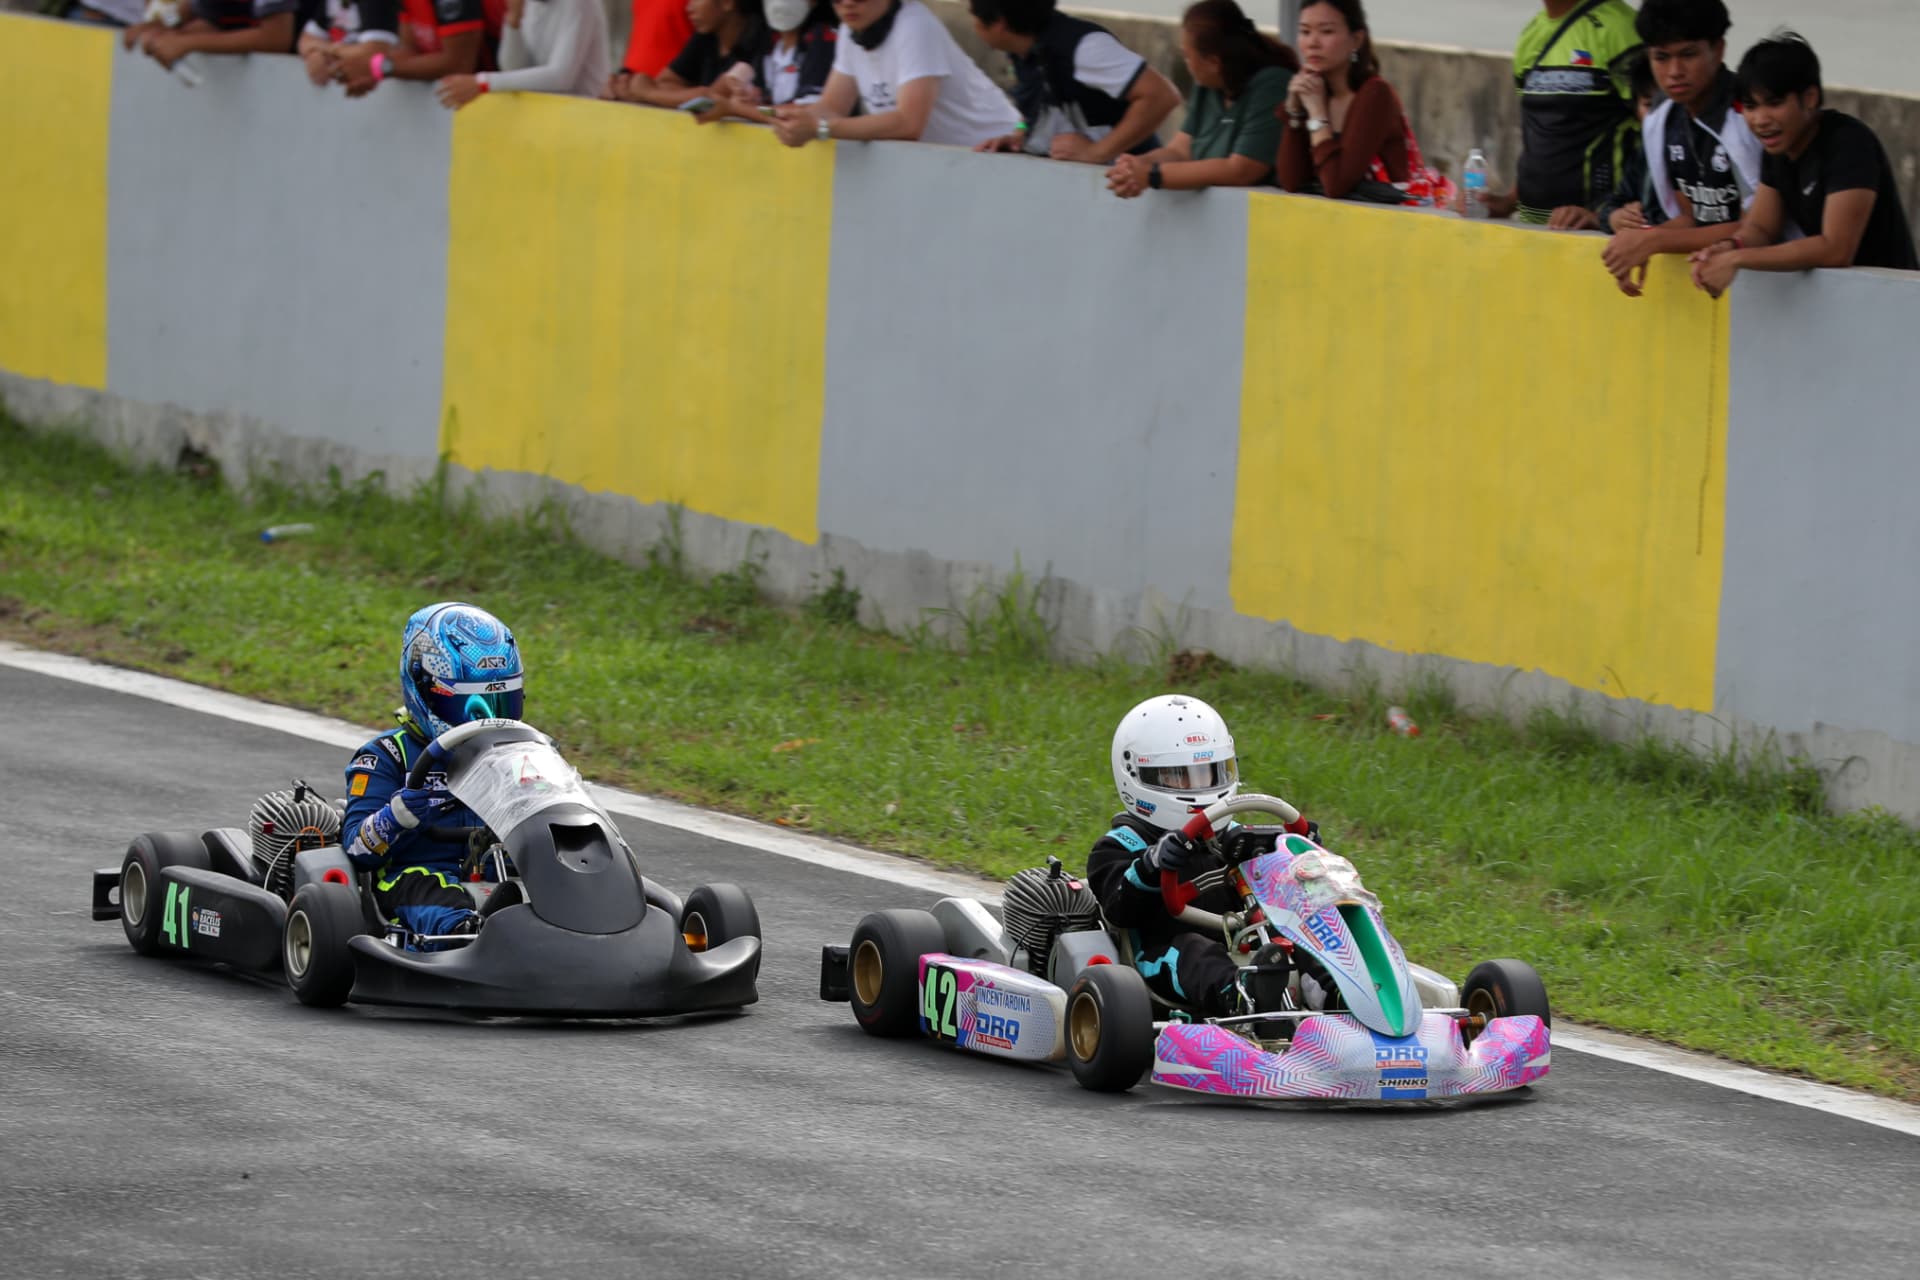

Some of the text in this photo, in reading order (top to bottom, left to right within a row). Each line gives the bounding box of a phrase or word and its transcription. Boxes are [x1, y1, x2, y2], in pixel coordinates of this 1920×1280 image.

[477, 657, 506, 667] ASR
[1186, 735, 1208, 743] BELL
[163, 881, 190, 948] 41
[924, 967, 957, 1038] 42
[976, 986, 1031, 1013] VINCENT ARDINA
[976, 1012, 1020, 1045] DRQ
